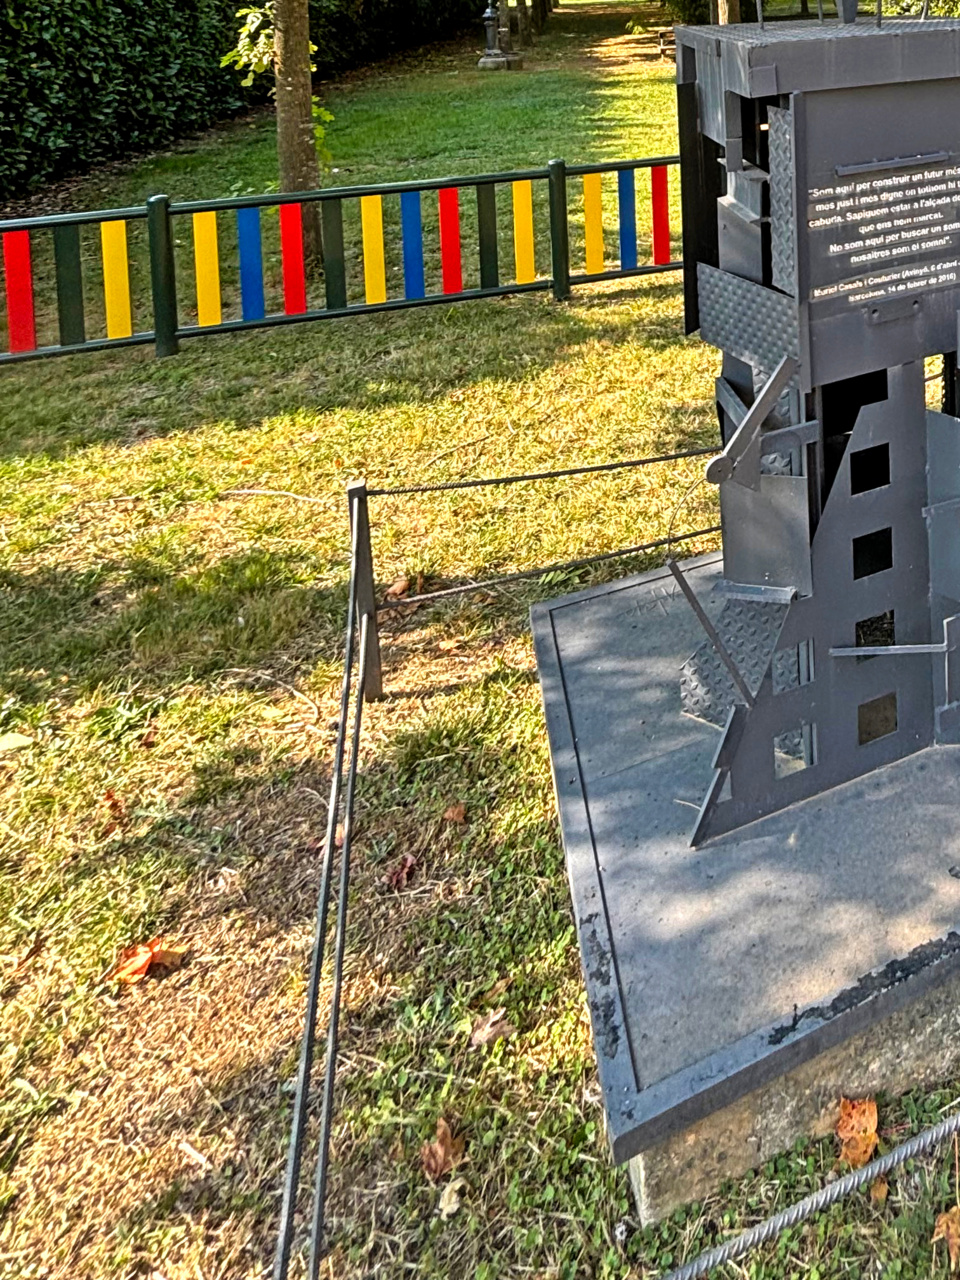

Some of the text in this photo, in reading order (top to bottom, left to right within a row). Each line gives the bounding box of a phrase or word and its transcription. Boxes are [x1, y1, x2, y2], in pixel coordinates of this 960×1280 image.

[835, 183, 855, 195] aquí
[856, 182, 871, 192] per
[872, 175, 910, 187] construir
[912, 173, 923, 181] un
[924, 170, 944, 179] futur
[816, 202, 835, 212] més
[836, 198, 854, 210] just
[860, 195, 878, 204] més
[880, 191, 904, 201] digne
[918, 184, 946, 194] tothom
[846, 207, 889, 221] Sapiguem
[890, 204, 911, 213] estar
[920, 196, 950, 208] l'alçada
[858, 223, 875, 234] que
[876, 221, 892, 230] ens
[894, 217, 912, 226] hem
[829, 244, 843, 253] No
[844, 240, 864, 250] som
[865, 235, 884, 246] aquí
[886, 233, 900, 244] per
[901, 228, 930, 238] buscar
[850, 249, 891, 264] nosaltres
[892, 245, 910, 255] som
[912, 243, 920, 251] el
[814, 286, 838, 297] Muriel
[838, 280, 863, 292] Casals
[868, 272, 901, 285] Couturier
[897, 284, 906, 292] de
[906, 279, 927, 289] febrer
